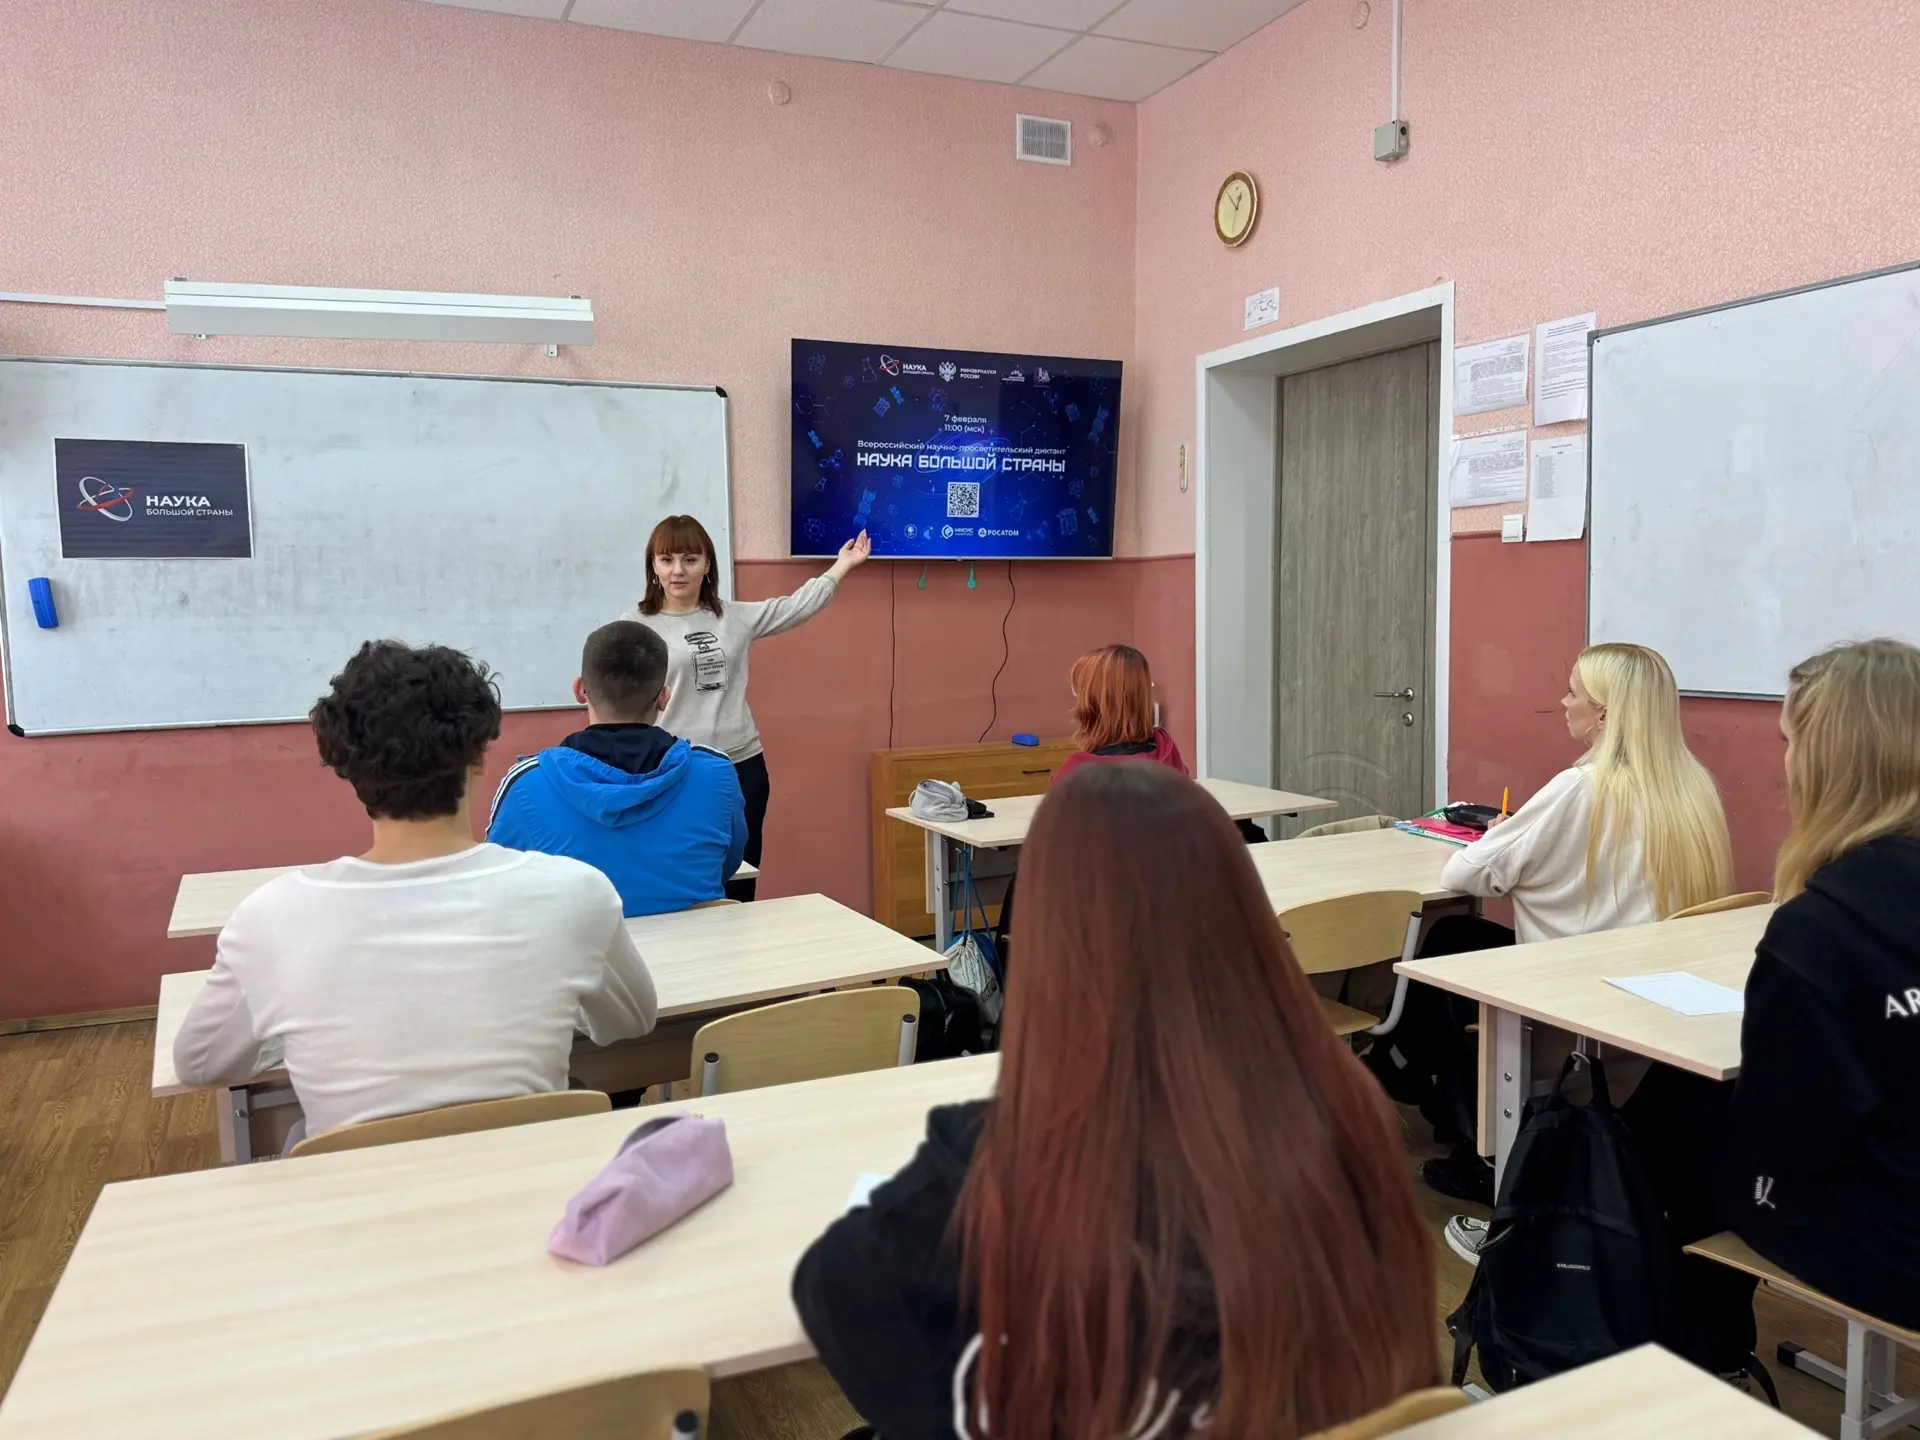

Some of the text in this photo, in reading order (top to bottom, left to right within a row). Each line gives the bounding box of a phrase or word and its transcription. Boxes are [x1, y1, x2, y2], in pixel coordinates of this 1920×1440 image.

[903, 363, 927, 371] НАУКА
[944, 414, 987, 424] 7 февраля
[944, 424, 985, 434] 11:00 (мск)
[857, 440, 925, 450] Всероссийский
[857, 452, 1066, 472] НАУКА БОЛЬШОЙ СТРАНЫ
[146, 495, 211, 508] НАУКА
[146, 507, 234, 516] БОЛЬШОЙ СТРАНЫ
[987, 529, 1019, 537] РОСАТОМ
